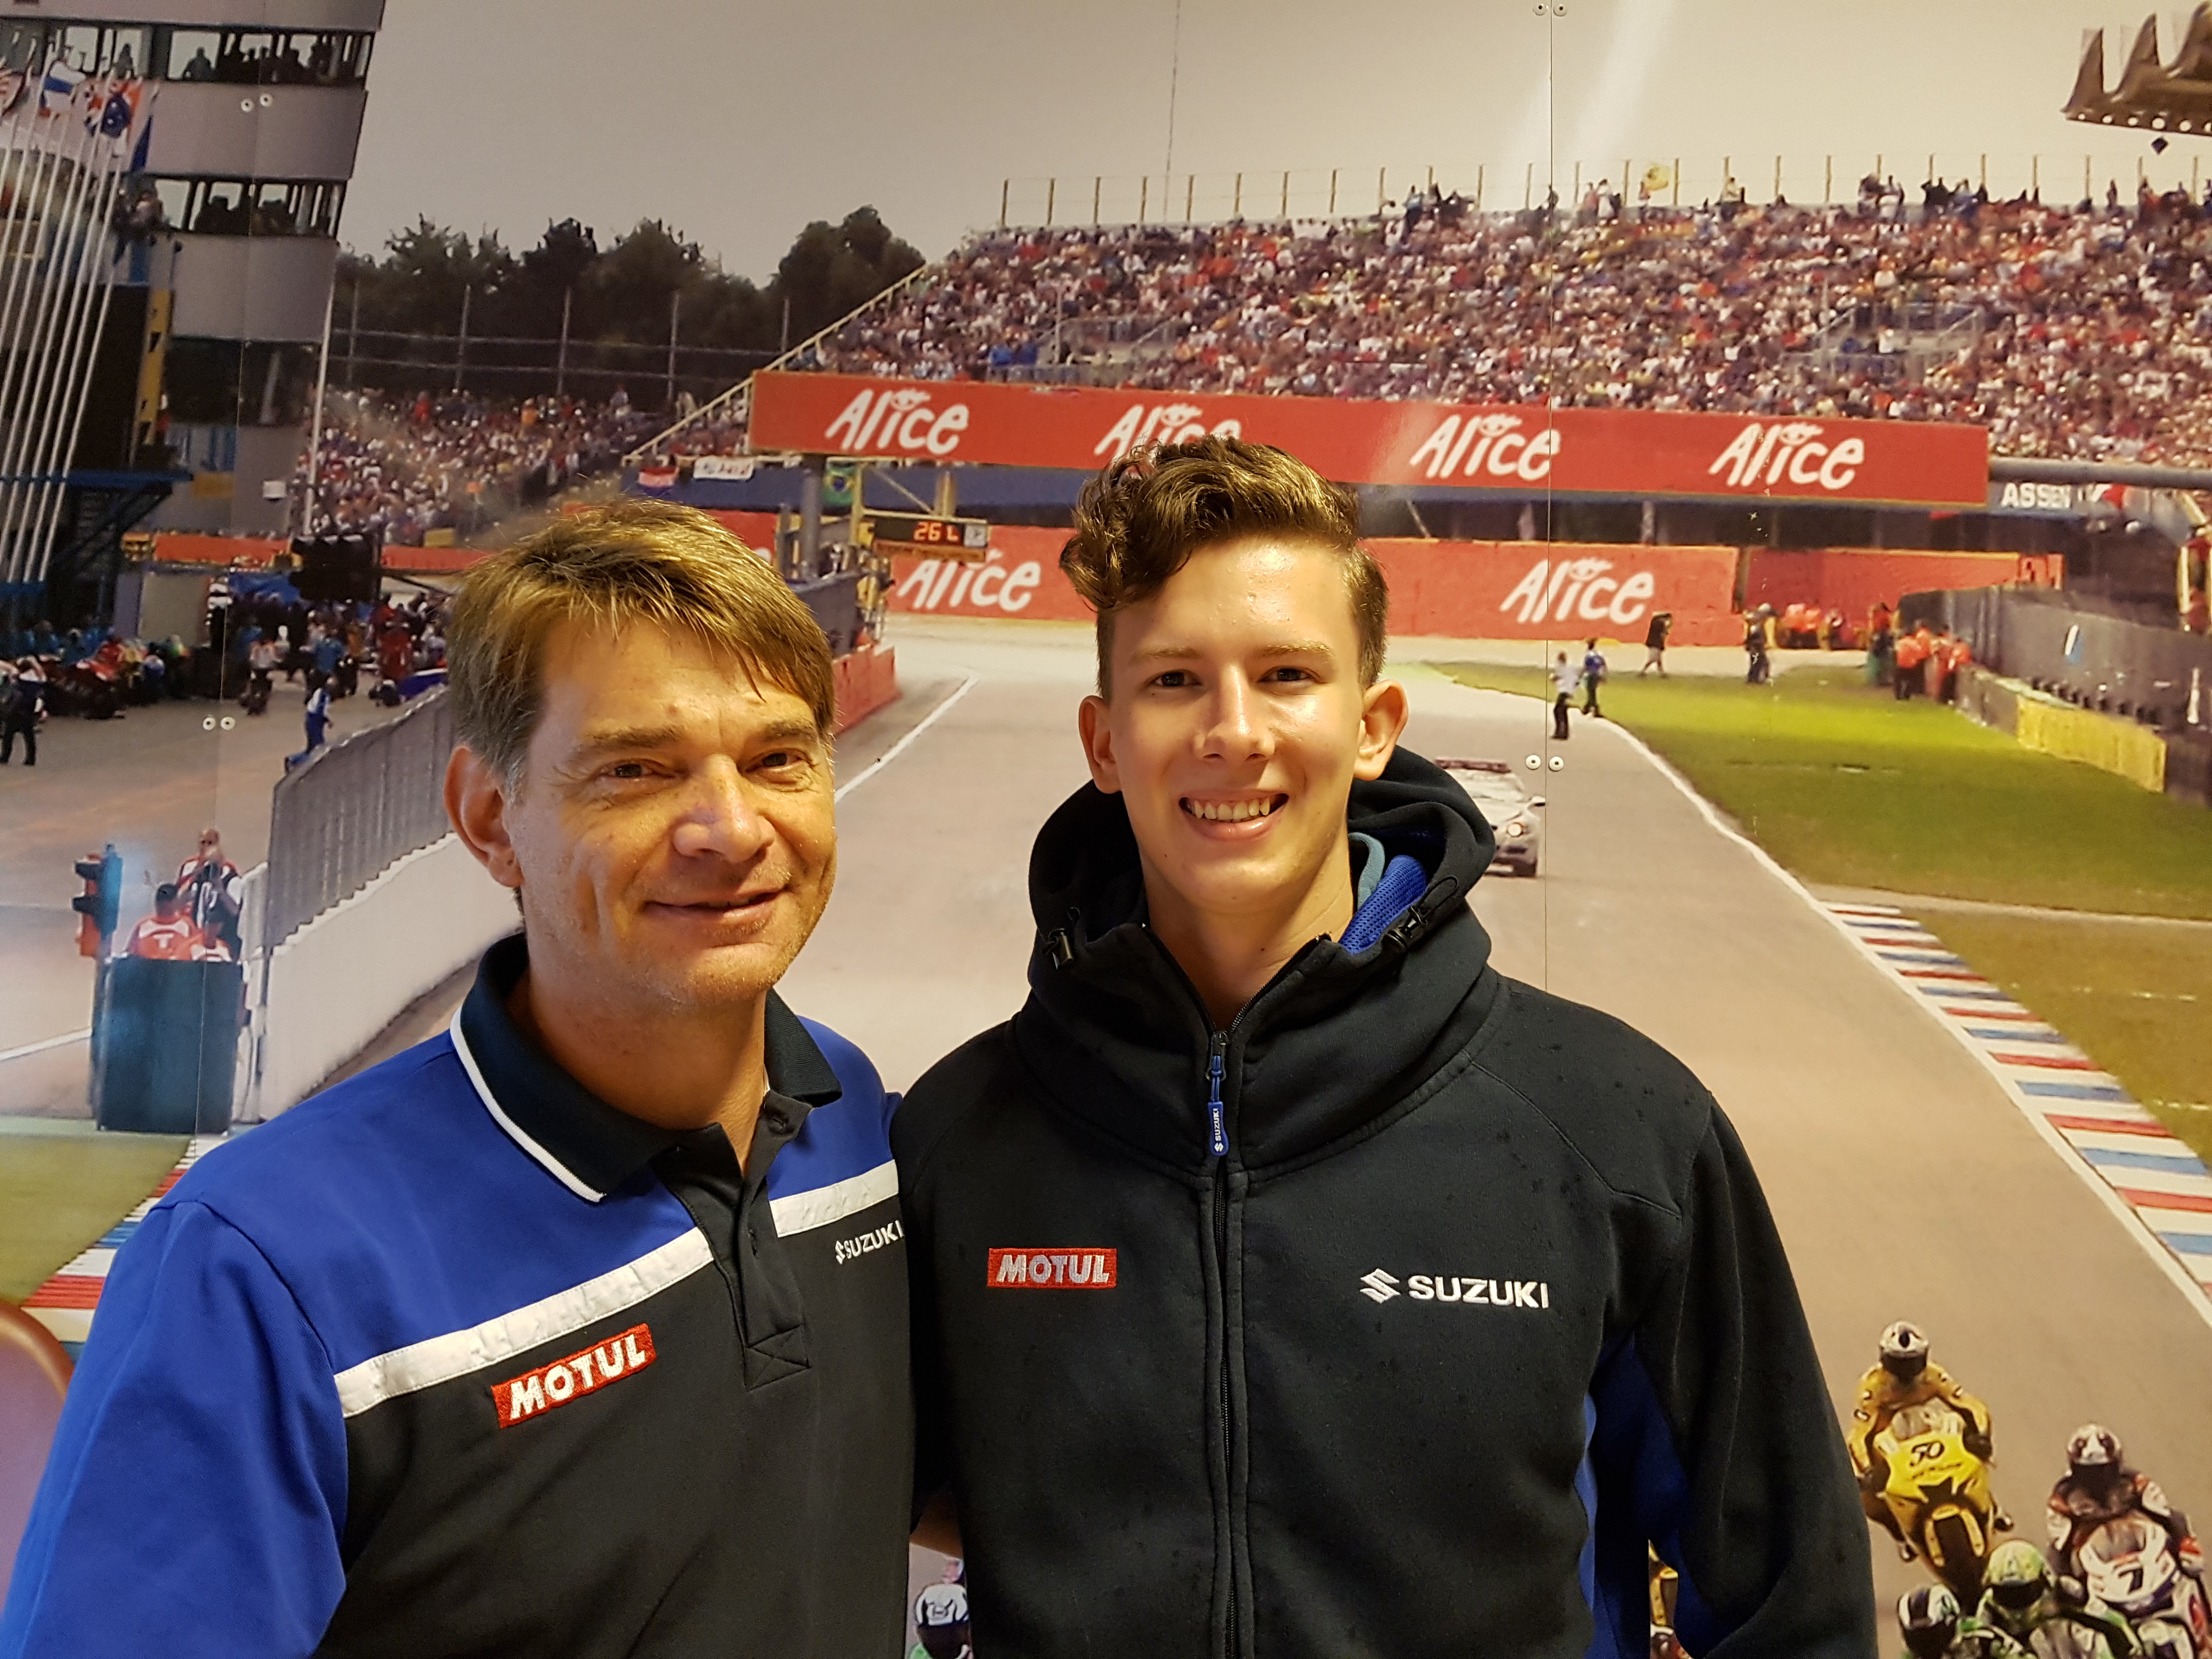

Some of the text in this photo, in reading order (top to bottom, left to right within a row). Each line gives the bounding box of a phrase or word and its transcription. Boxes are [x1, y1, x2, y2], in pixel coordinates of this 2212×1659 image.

[824, 387, 970, 455] Alice
[1409, 414, 1561, 481] Alice
[1707, 422, 1865, 490] Alice
[913, 521, 943, 542] 26
[896, 549, 1042, 612] Alice
[1499, 557, 1655, 625] Alice
[1213, 1109, 1221, 1141] SUZUKI
[844, 1220, 904, 1259] SUZUKI
[995, 1254, 1110, 1284] MOTUL
[1407, 1274, 1549, 1309] SUZUKI
[509, 1333, 646, 1421] MOTUL
